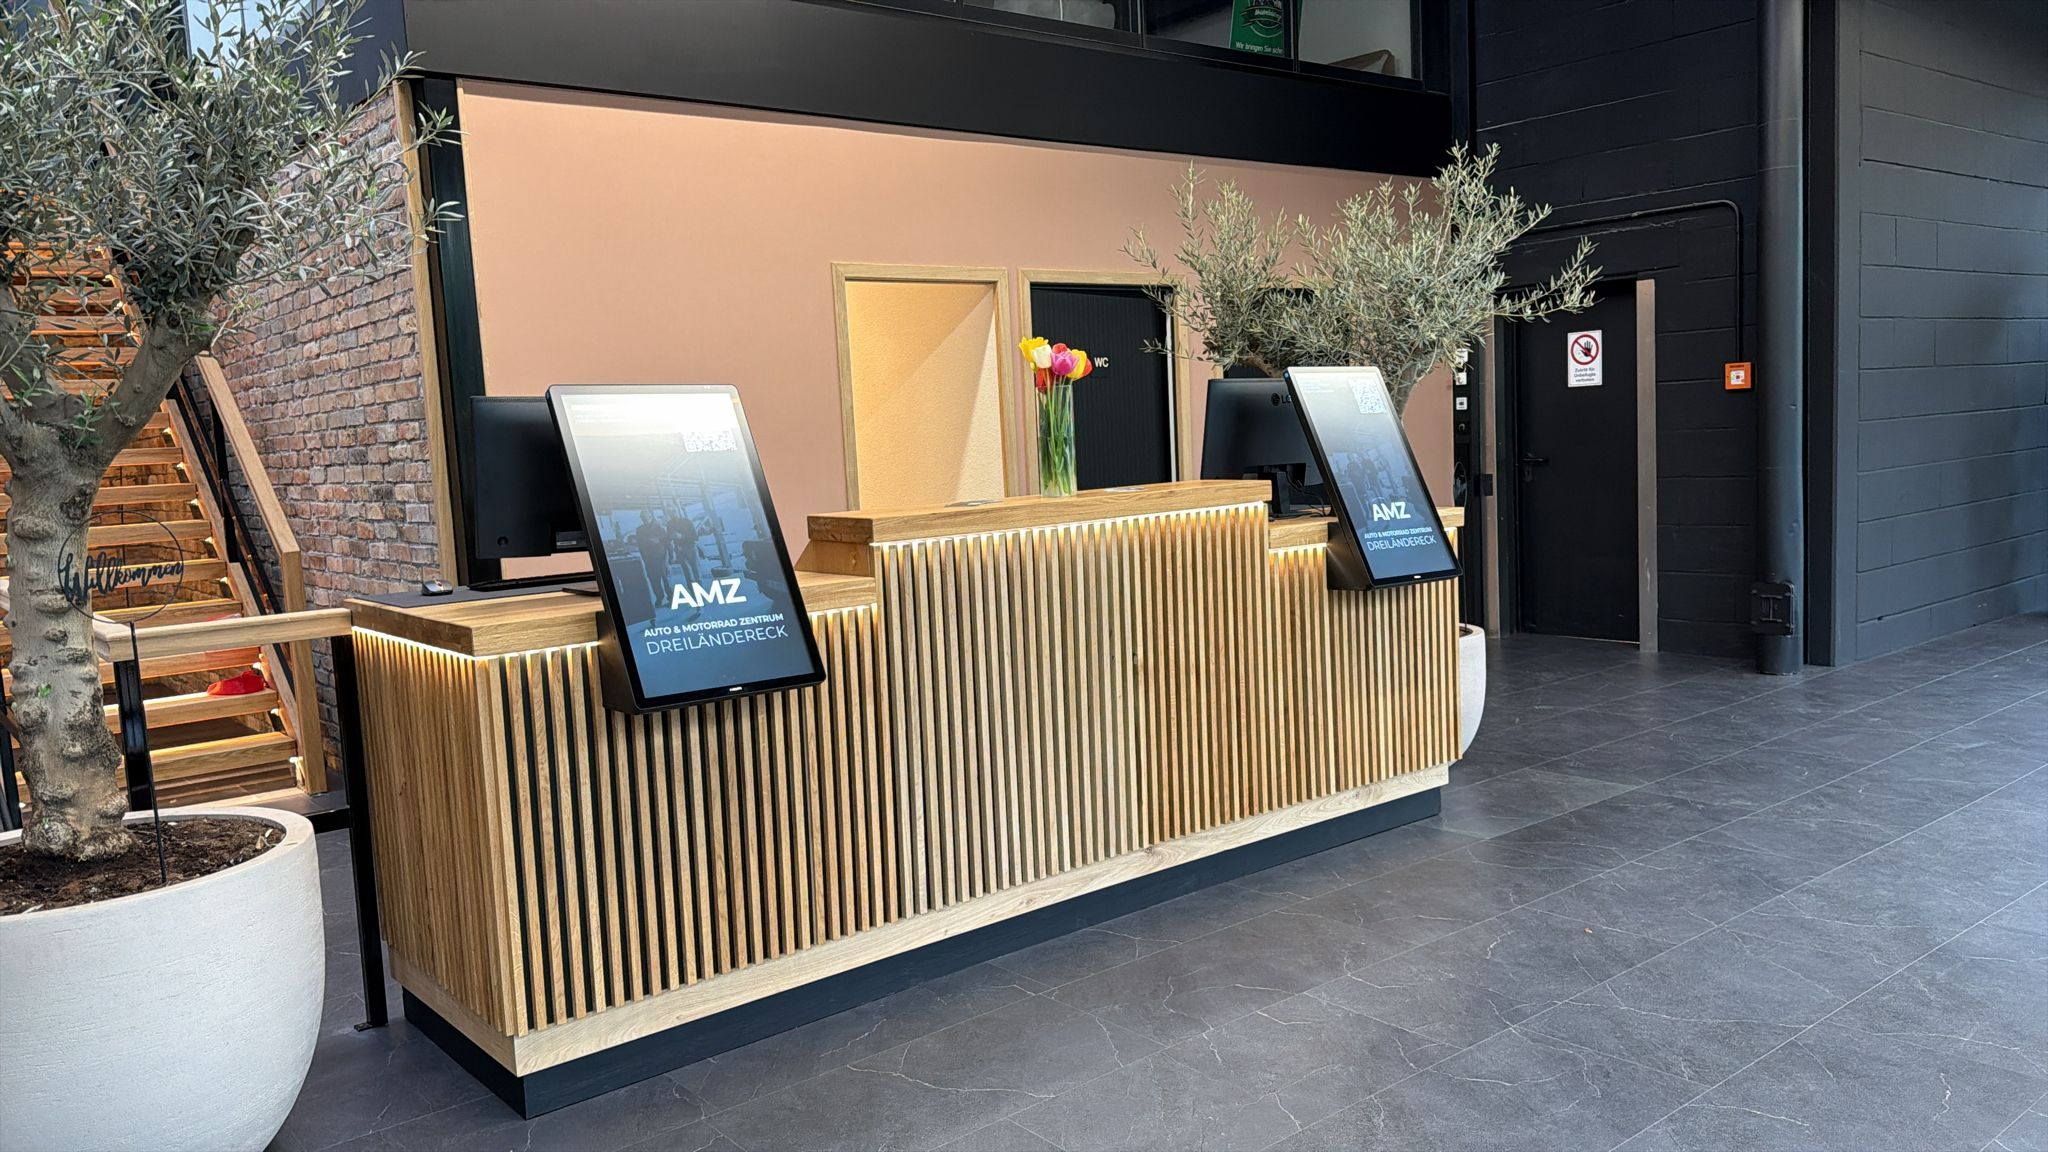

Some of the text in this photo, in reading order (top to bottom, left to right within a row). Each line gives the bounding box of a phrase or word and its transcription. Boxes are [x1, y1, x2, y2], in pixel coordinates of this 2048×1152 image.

[1094, 357, 1109, 368] WC
[1372, 501, 1411, 522] AMZ
[1364, 531, 1378, 539] AUTO
[1382, 529, 1410, 538] MOTORRAD
[1409, 526, 1433, 535] ZENTRUM
[1366, 535, 1437, 551] DREILÄNDERECK
[59, 551, 183, 602] Willkommen
[671, 577, 747, 609] AMZ
[644, 612, 784, 637] AUTO & MOTORRAD ZENTRUM
[646, 625, 788, 655] DREILÄNDERECK
